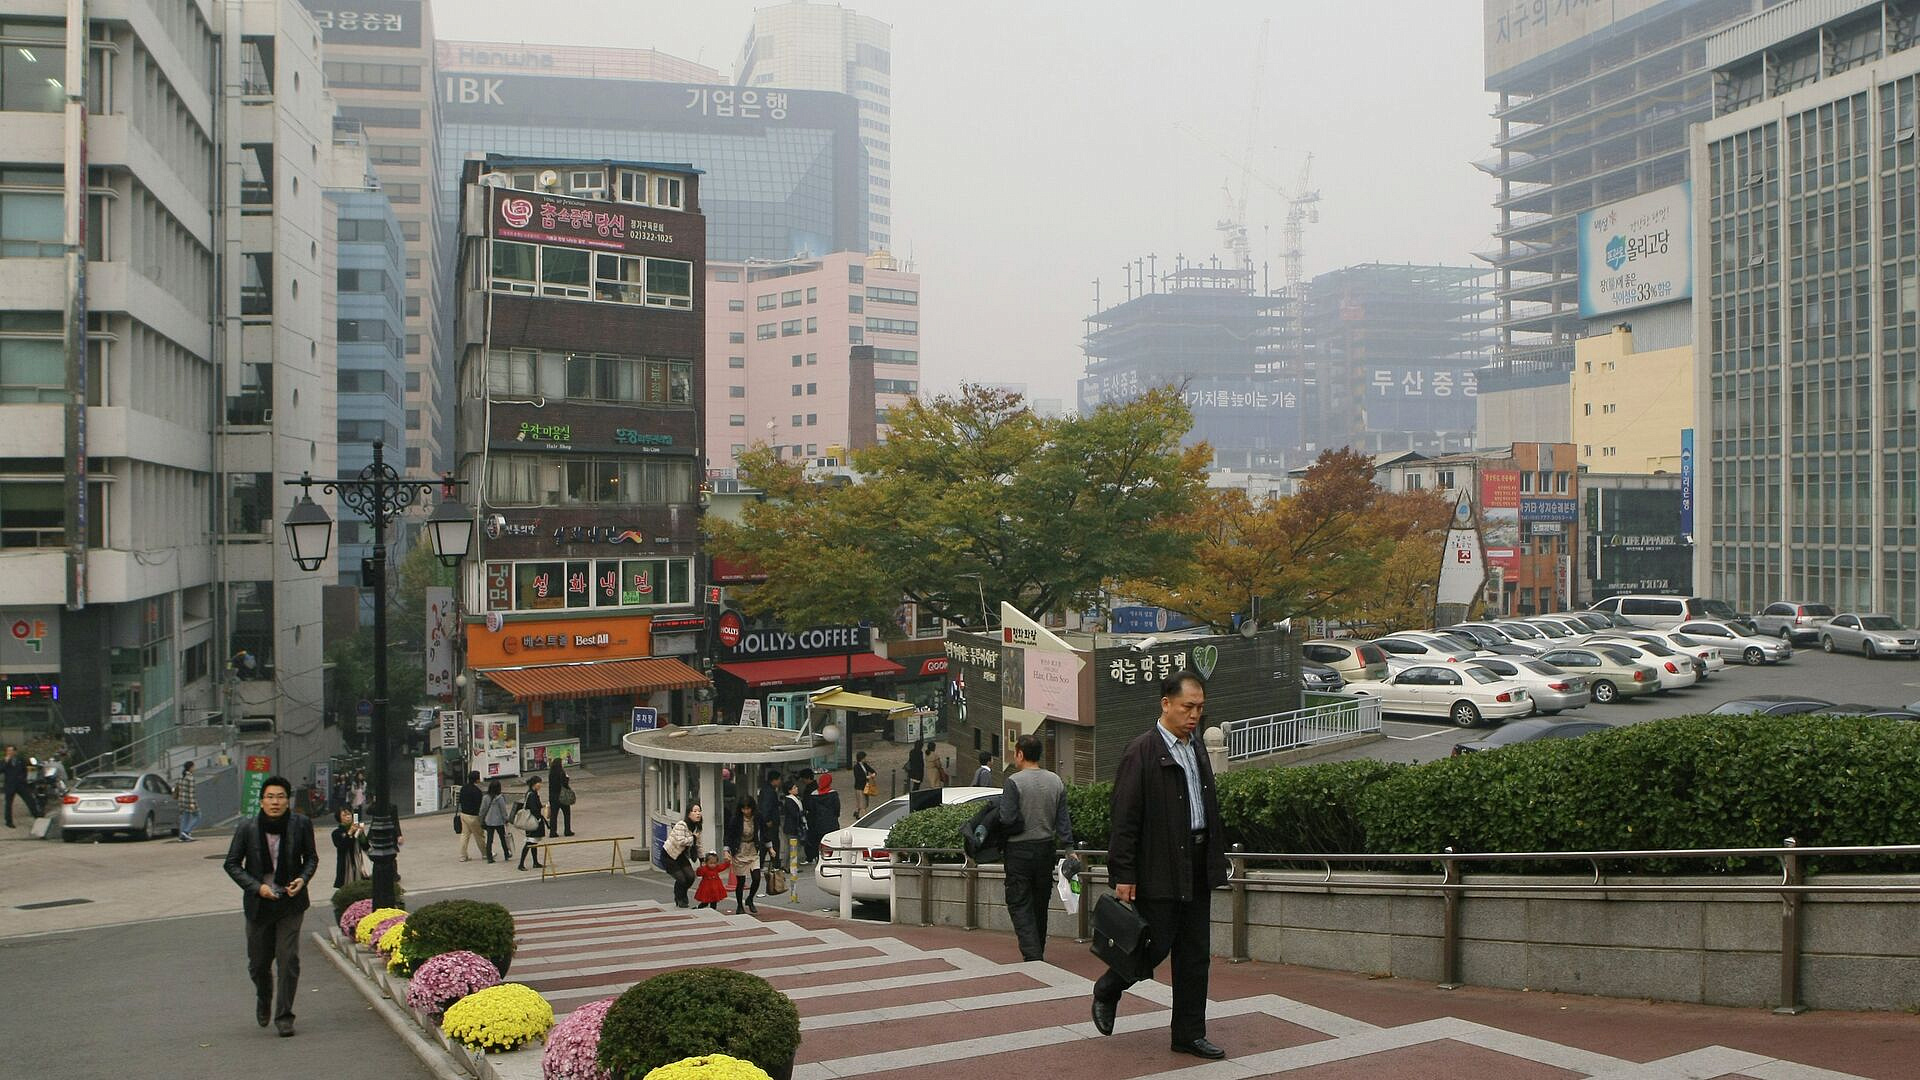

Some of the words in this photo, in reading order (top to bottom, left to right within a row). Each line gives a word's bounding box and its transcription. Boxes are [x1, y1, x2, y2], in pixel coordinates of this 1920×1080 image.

[459, 48, 553, 67] Hanwha
[446, 77, 504, 105] IBK
[685, 89, 788, 120] 기업은행
[594, 211, 625, 238] 당신
[1627, 229, 1669, 262] 올리고당
[1191, 390, 1229, 407] 가치를
[1231, 390, 1268, 408] 높이는
[1272, 391, 1297, 408] 기술
[1682, 465, 1690, 511] 우리은행
[1538, 502, 1577, 514] 성지순례본부
[489, 565, 509, 609] 냉면
[533, 570, 653, 598] 설화냉면
[575, 635, 596, 647] Best
[597, 633, 609, 644] All
[720, 627, 739, 636] HOLLYS
[800, 627, 860, 650] COFFEE
[1110, 658, 1138, 685] 하늘
[1141, 655, 1155, 682] 땅
[1157, 654, 1171, 680] 물
